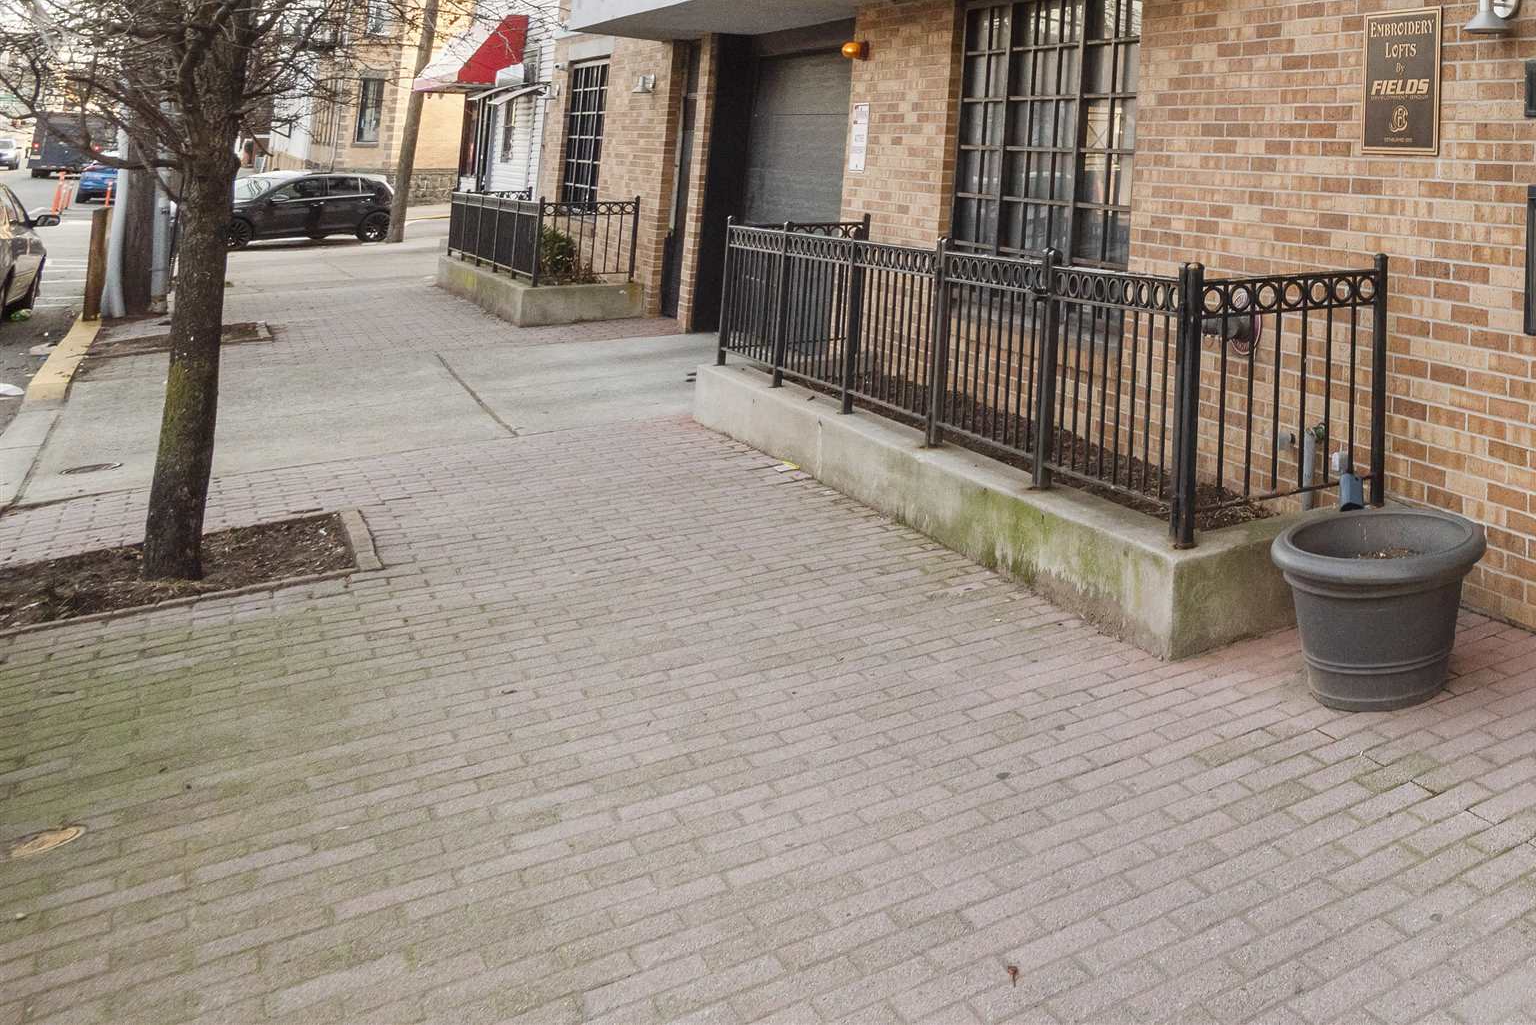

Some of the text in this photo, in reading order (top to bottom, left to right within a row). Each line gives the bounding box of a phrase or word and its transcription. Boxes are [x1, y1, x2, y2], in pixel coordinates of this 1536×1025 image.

[1370, 19, 1434, 38] EMBROIDERY
[1385, 42, 1417, 59] LOFTS
[1371, 78, 1430, 96] FIELDS
